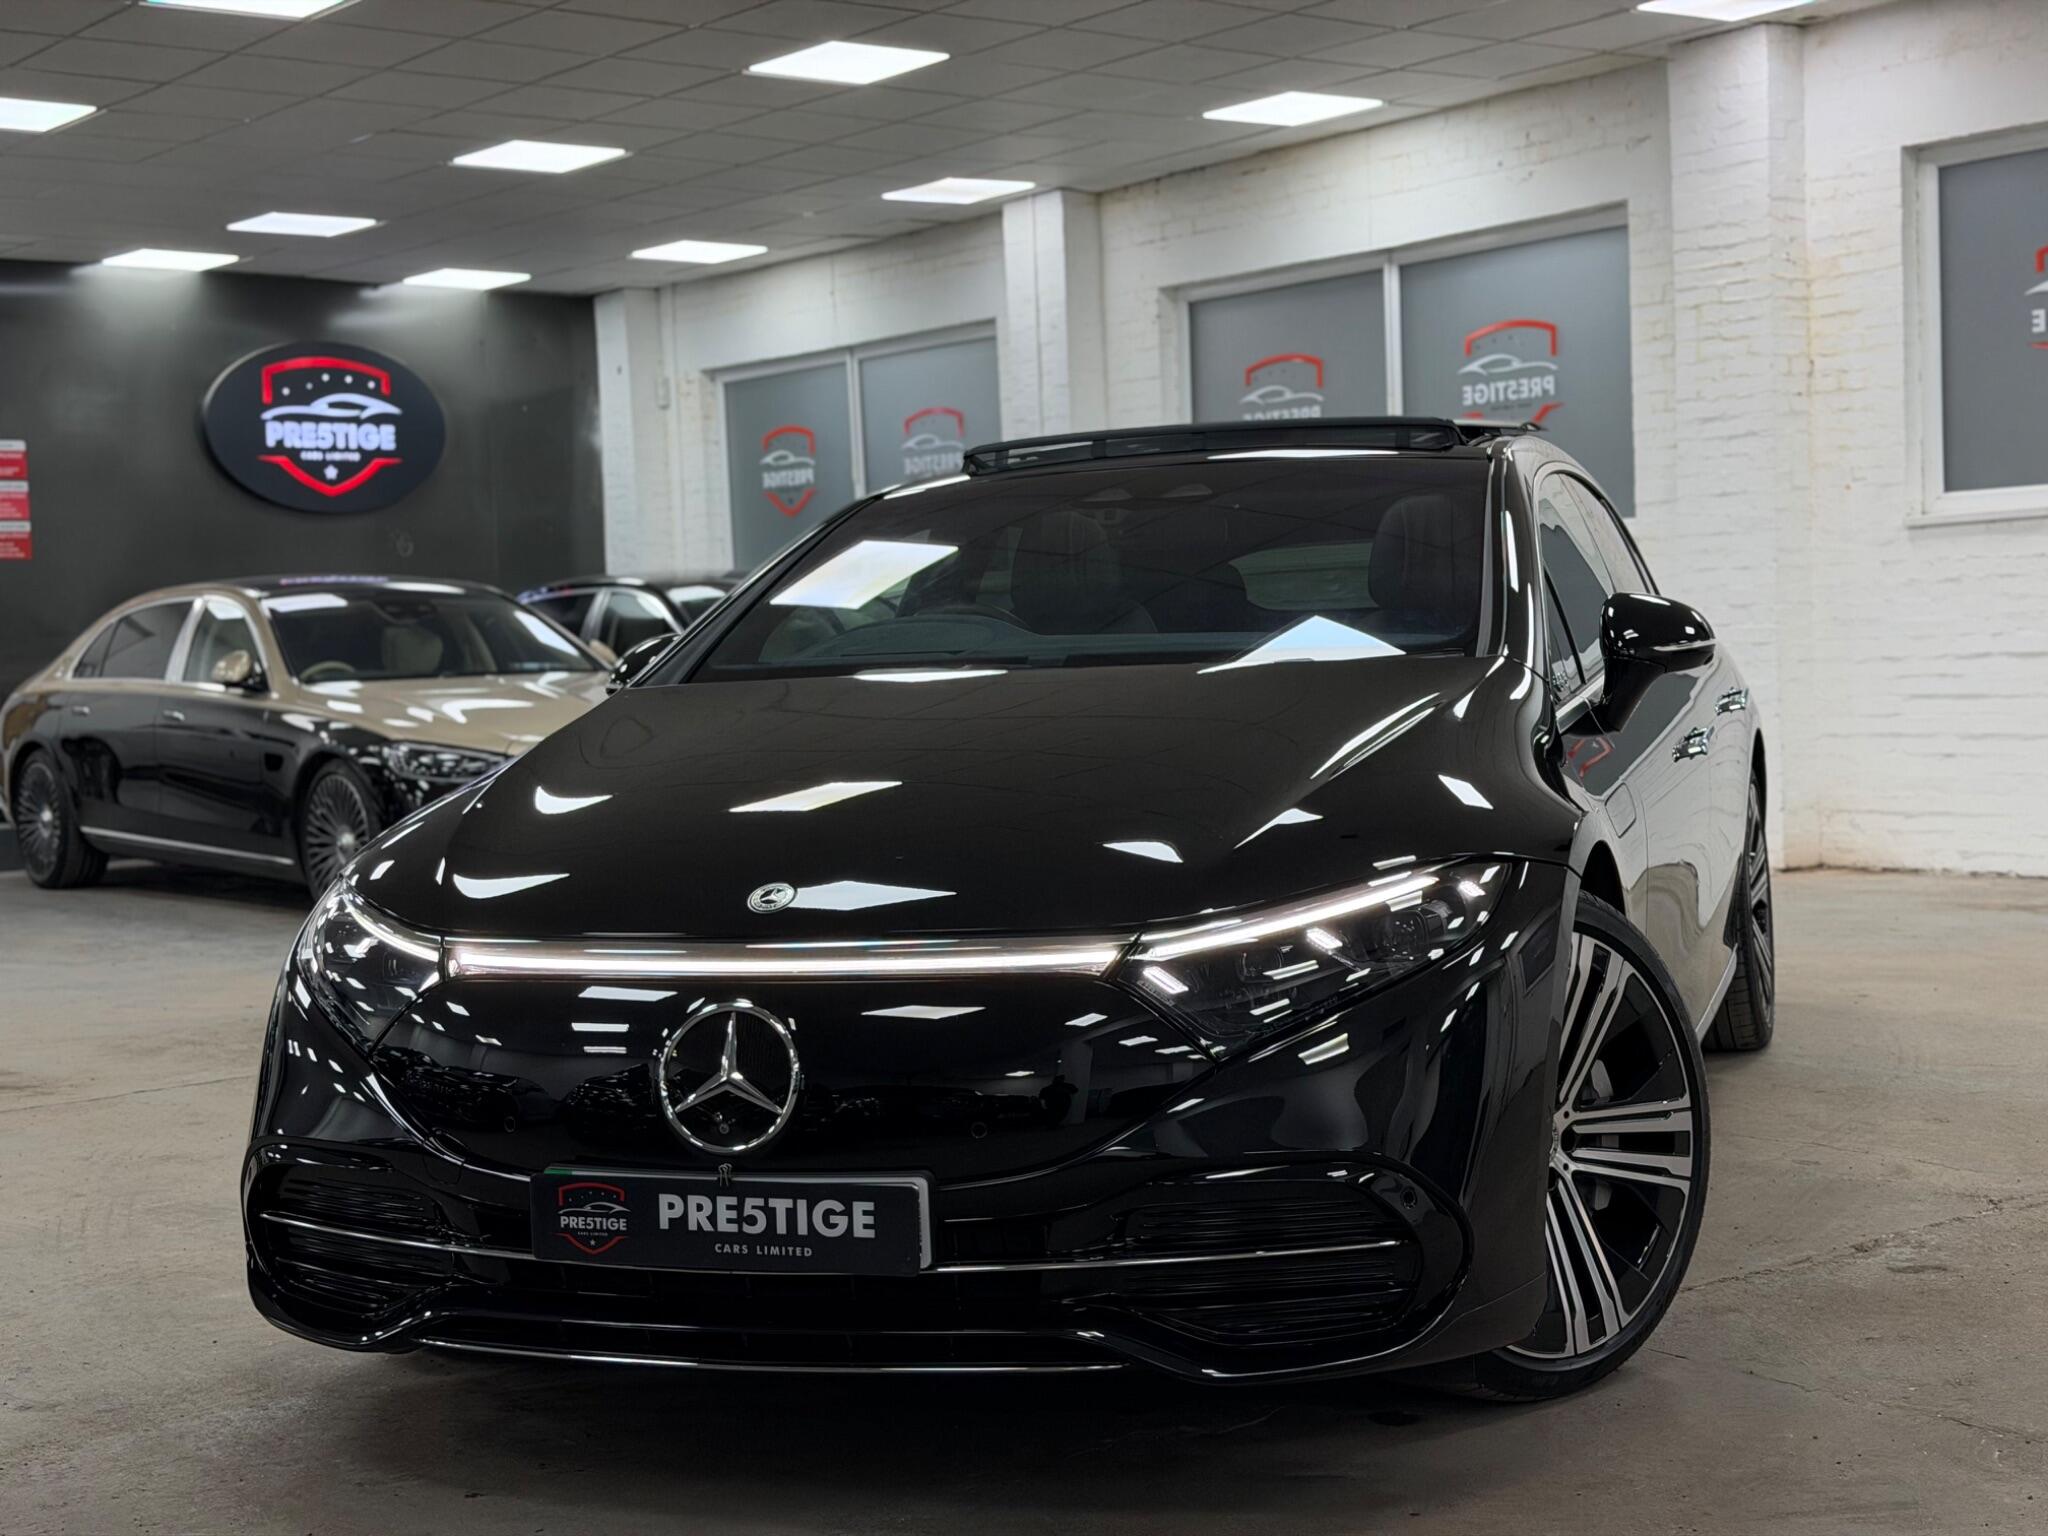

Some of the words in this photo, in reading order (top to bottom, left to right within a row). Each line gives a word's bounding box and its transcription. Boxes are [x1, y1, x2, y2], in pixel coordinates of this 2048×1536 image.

[560, 1216, 627, 1231] PRE5TIGE
[657, 1193, 876, 1239] PRE5TIGE
[714, 1243, 748, 1254] CARS
[756, 1245, 812, 1257] LIMITED
